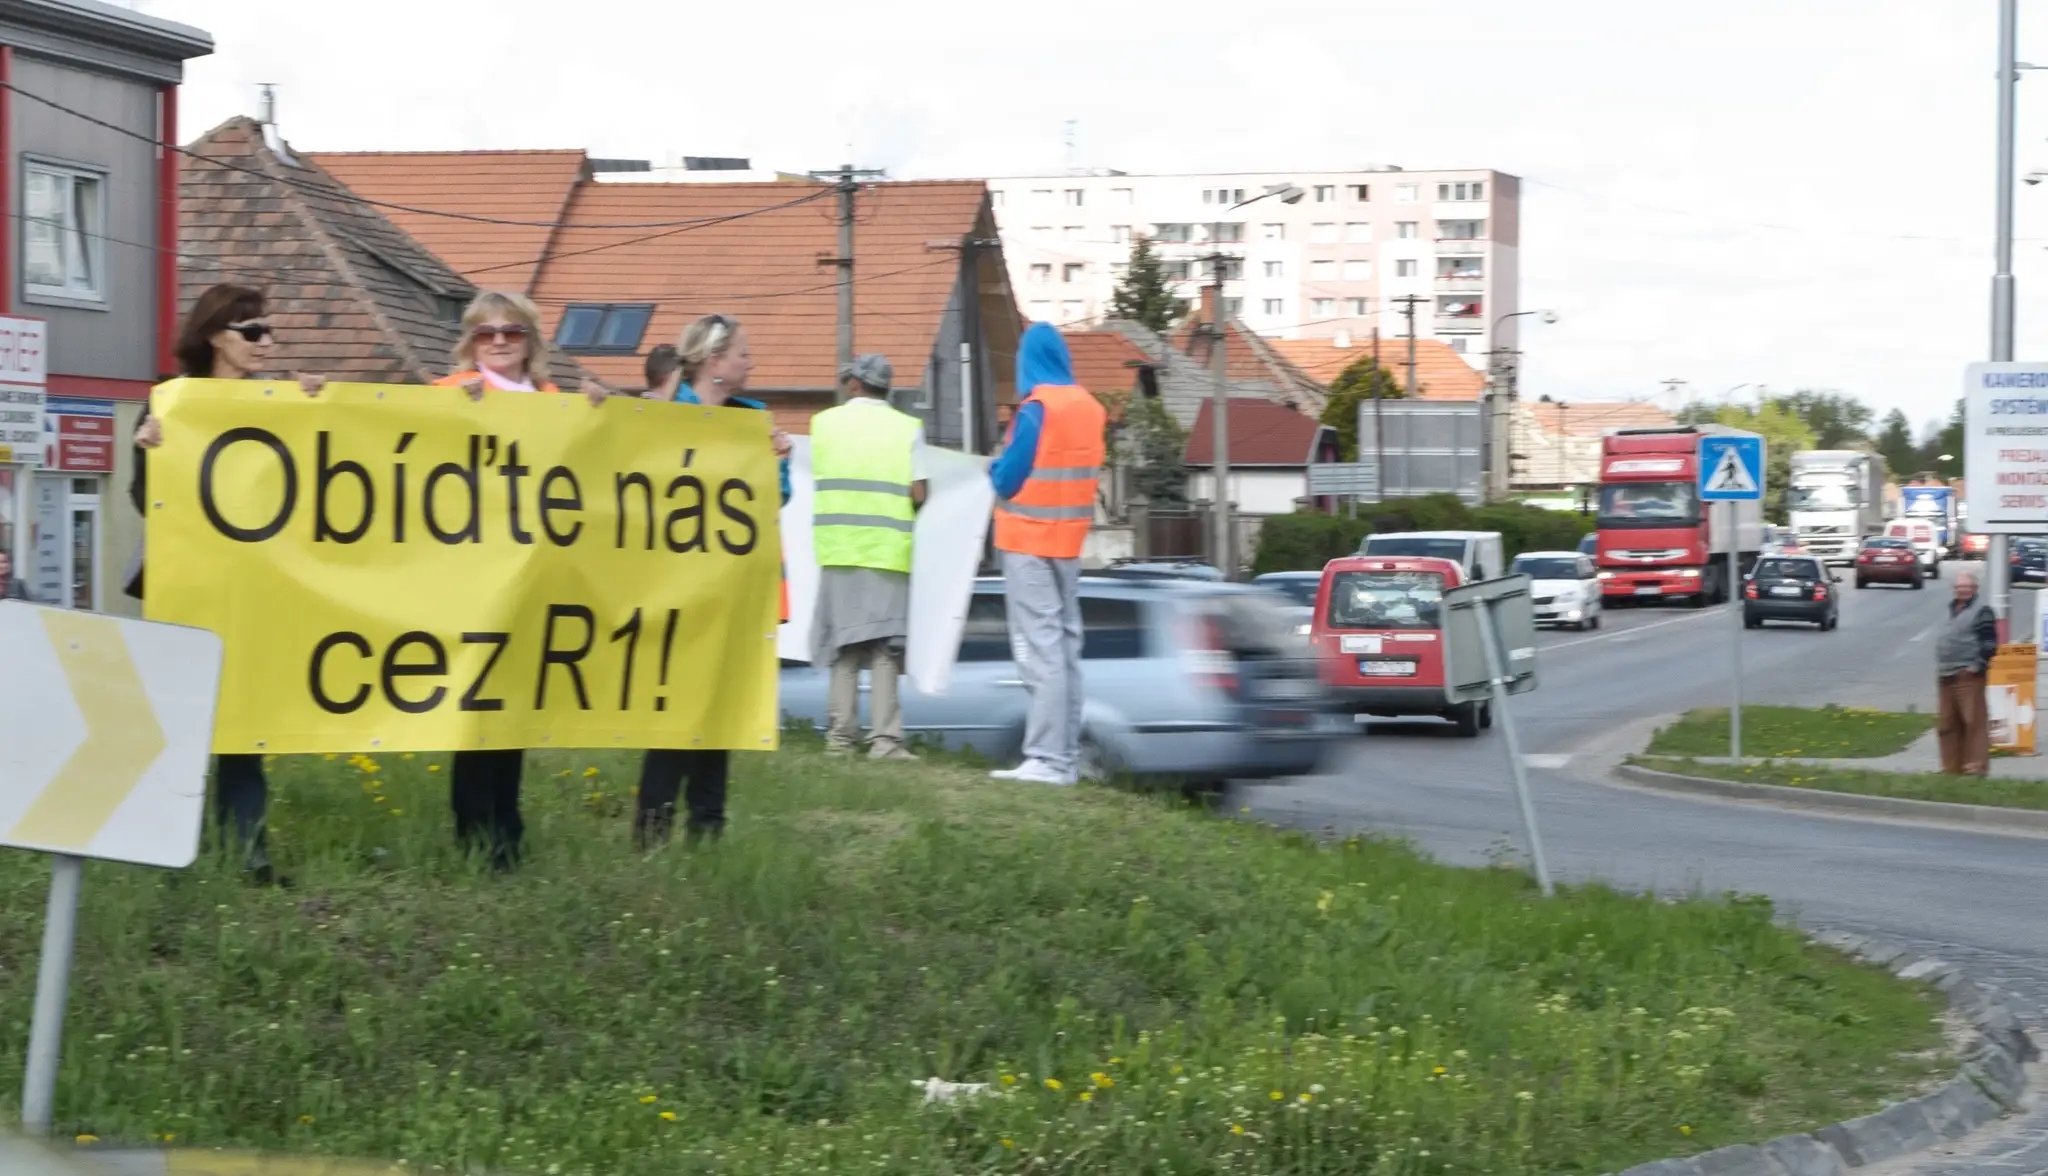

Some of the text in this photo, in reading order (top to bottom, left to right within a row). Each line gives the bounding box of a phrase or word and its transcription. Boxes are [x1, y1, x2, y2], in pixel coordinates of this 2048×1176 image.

[200, 427, 756, 555] Obíďte nás
[309, 604, 678, 714] cez R1!
